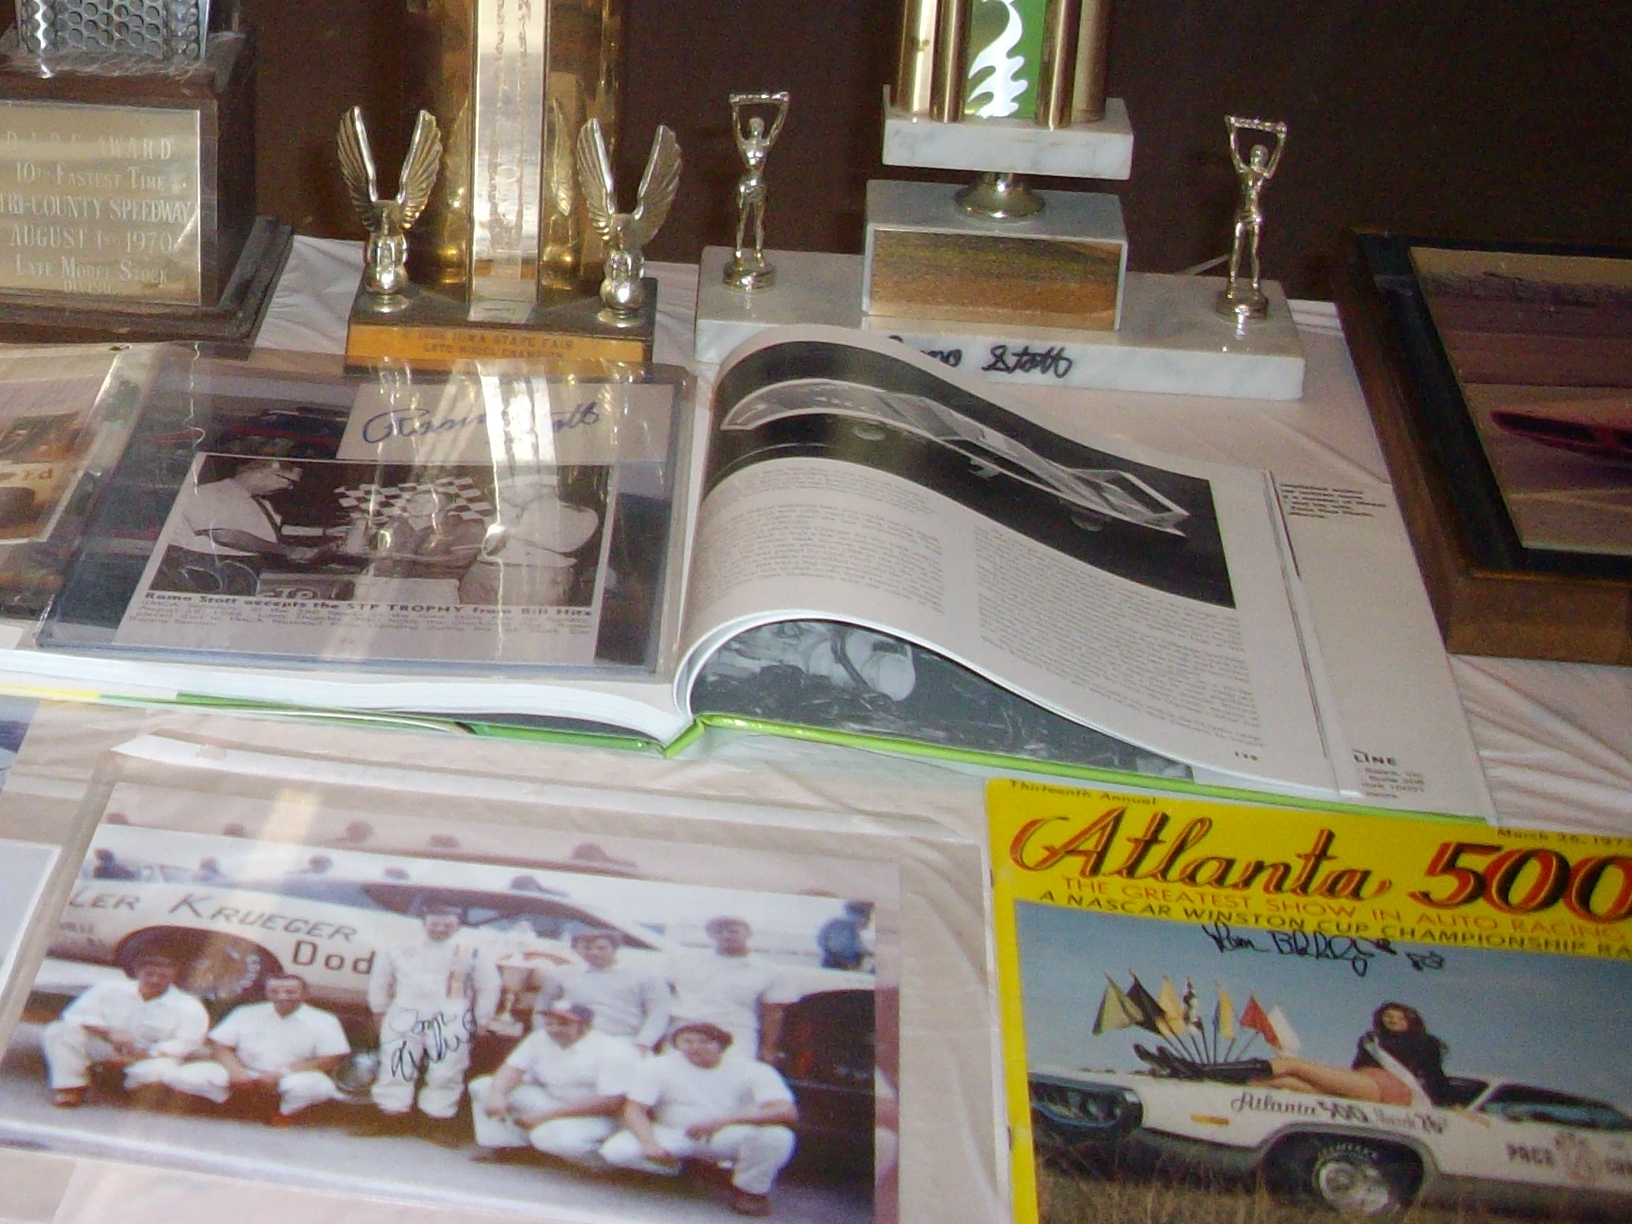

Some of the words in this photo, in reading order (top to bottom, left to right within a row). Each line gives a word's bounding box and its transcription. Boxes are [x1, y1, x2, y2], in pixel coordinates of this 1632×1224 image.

[109, 198, 191, 224] SPEEDWAY
[9, 223, 88, 249] AUGUST
[125, 231, 174, 255] 1970
[387, 603, 467, 614] TROPHY
[1009, 779, 1093, 798] Thirteenth
[1099, 792, 1158, 806] Annual
[1497, 828, 1549, 841] March
[1009, 805, 1393, 901] Atlanta
[1407, 841, 1632, 925] 500
[169, 890, 360, 944] KRUEGER
[1039, 889, 1056, 902] A
[1066, 893, 1172, 917] NASCAR
[1182, 905, 1306, 929] WINSTON
[1316, 919, 1369, 935] CUP
[1379, 926, 1586, 954] CHAMPIONSHIP
[1064, 877, 1110, 896] THE
[1121, 886, 1251, 910] GREATEST
[1266, 899, 1357, 918] SHOW
[1371, 908, 1402, 923] IN
[1416, 911, 1499, 931] AUTO
[1509, 917, 1628, 943] RACING
[1229, 1089, 1318, 1119] Atlanta
